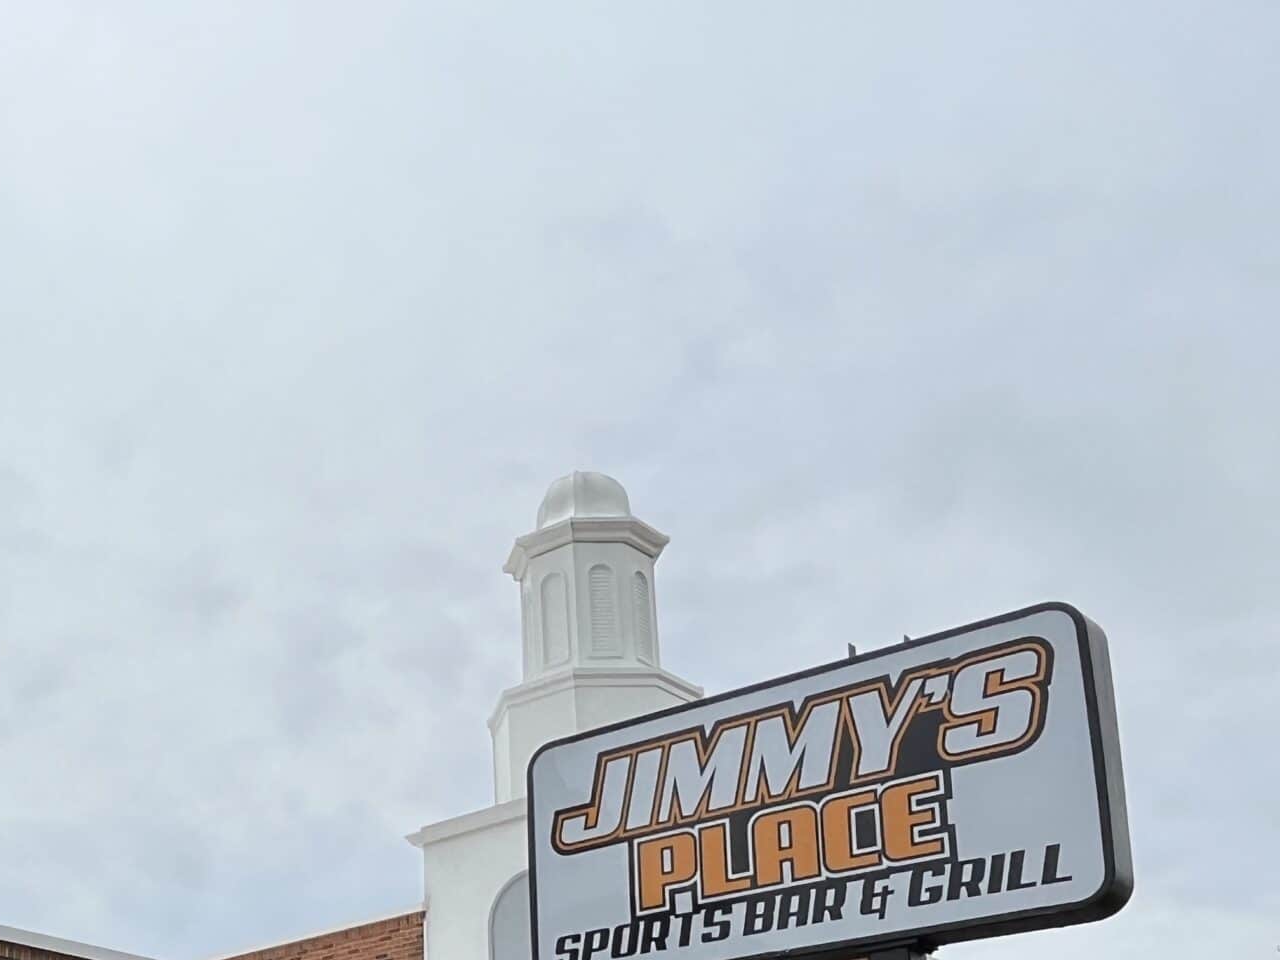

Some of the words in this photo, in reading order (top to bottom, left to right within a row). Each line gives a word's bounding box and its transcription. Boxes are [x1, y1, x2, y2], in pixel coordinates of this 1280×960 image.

[551, 636, 1054, 855] JIMMY'S
[632, 770, 951, 917] PLACE
[743, 881, 847, 937] BAR
[860, 878, 895, 921] &
[908, 843, 1073, 909] GRILL
